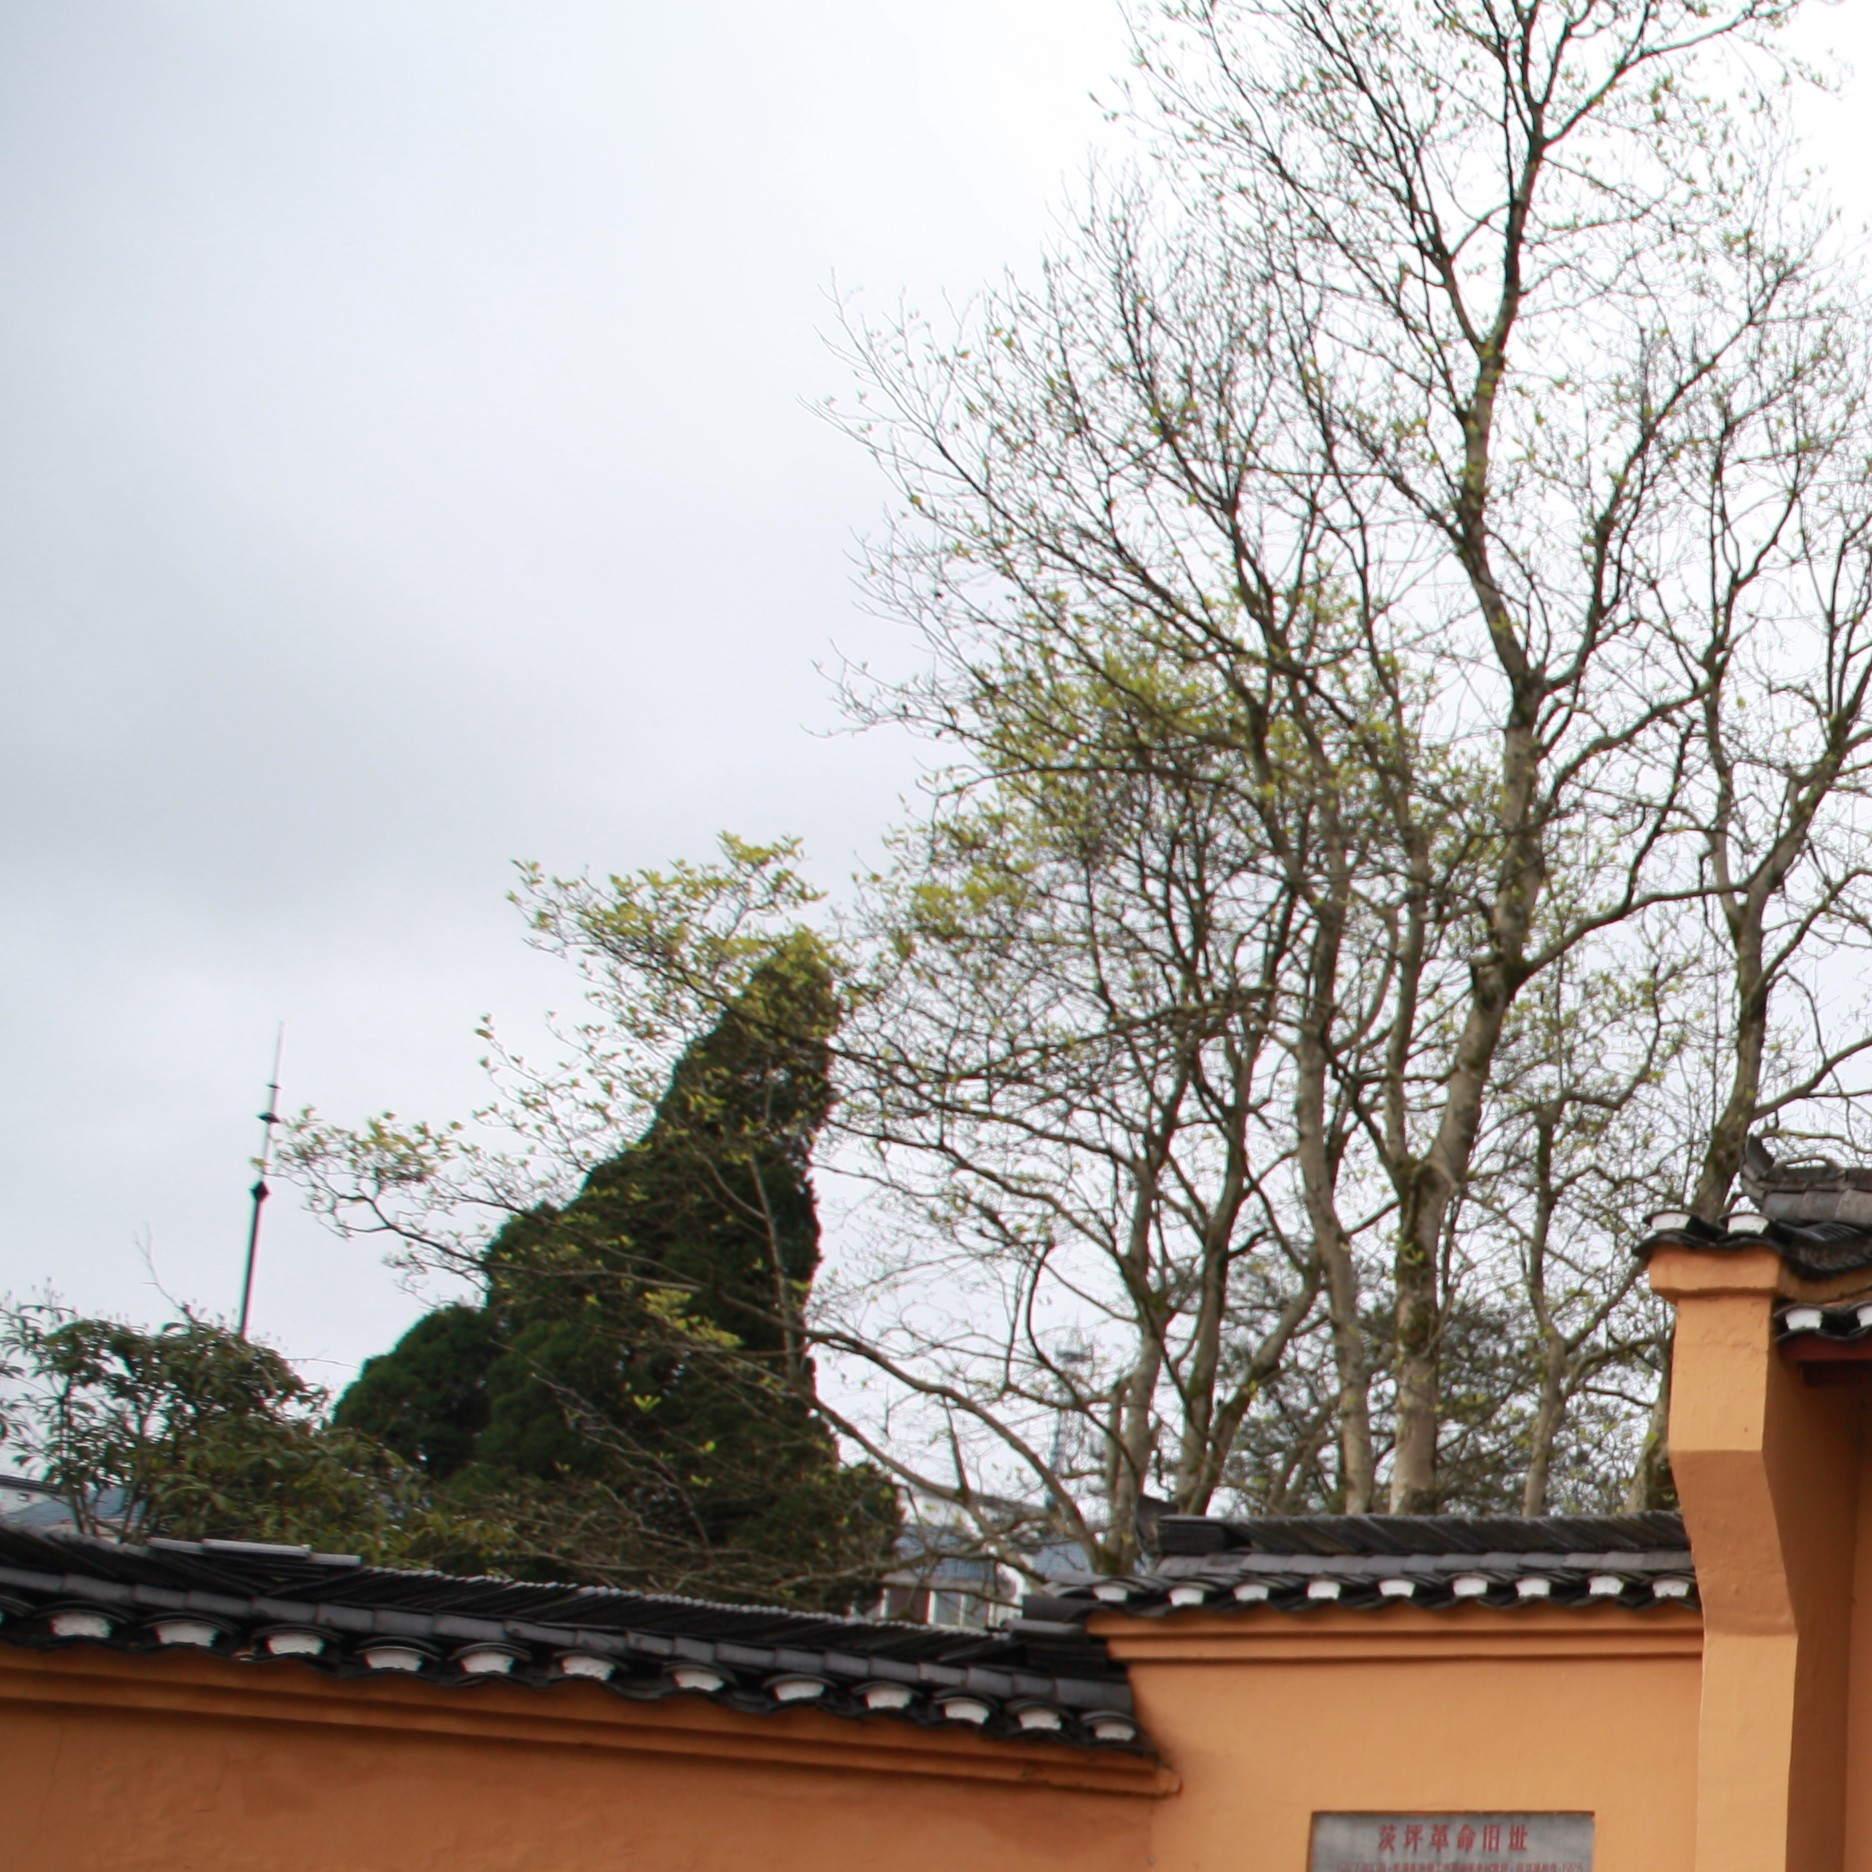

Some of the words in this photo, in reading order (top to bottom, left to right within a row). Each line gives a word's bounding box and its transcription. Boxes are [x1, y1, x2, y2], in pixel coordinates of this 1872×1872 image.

[1378, 1825, 1528, 1853] 茨坪革命旧址
